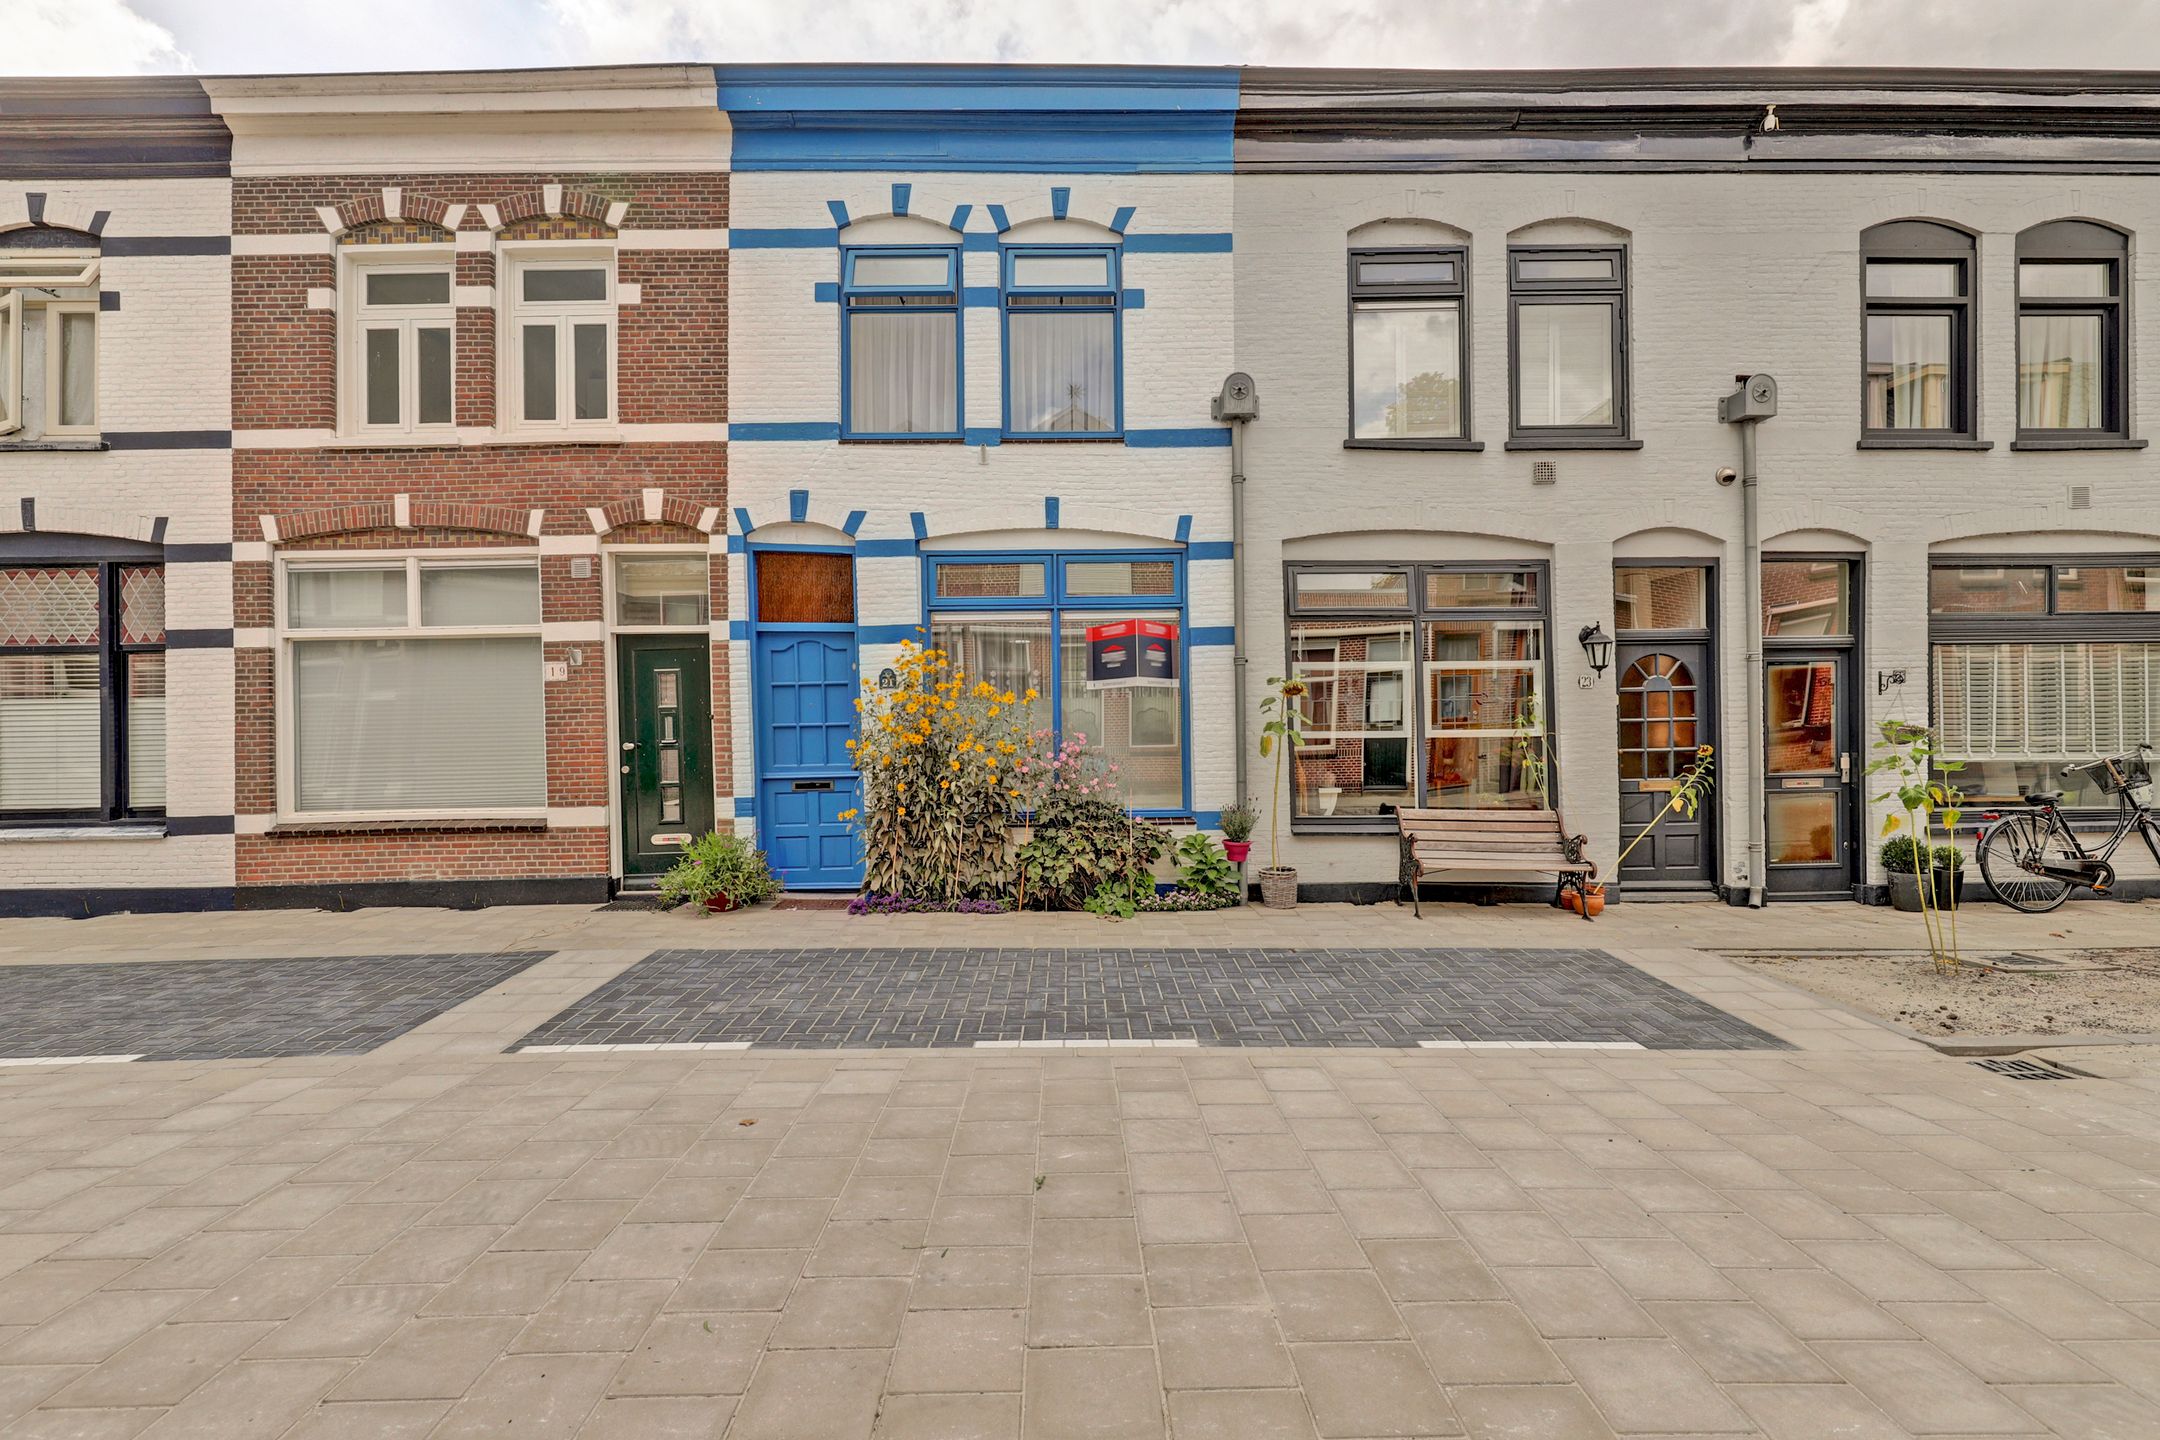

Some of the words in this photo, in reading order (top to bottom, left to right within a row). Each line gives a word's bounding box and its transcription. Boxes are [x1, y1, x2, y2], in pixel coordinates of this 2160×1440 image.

[551, 666, 565, 677] 19
[882, 678, 894, 687] 21
[1581, 676, 1592, 688] 23
